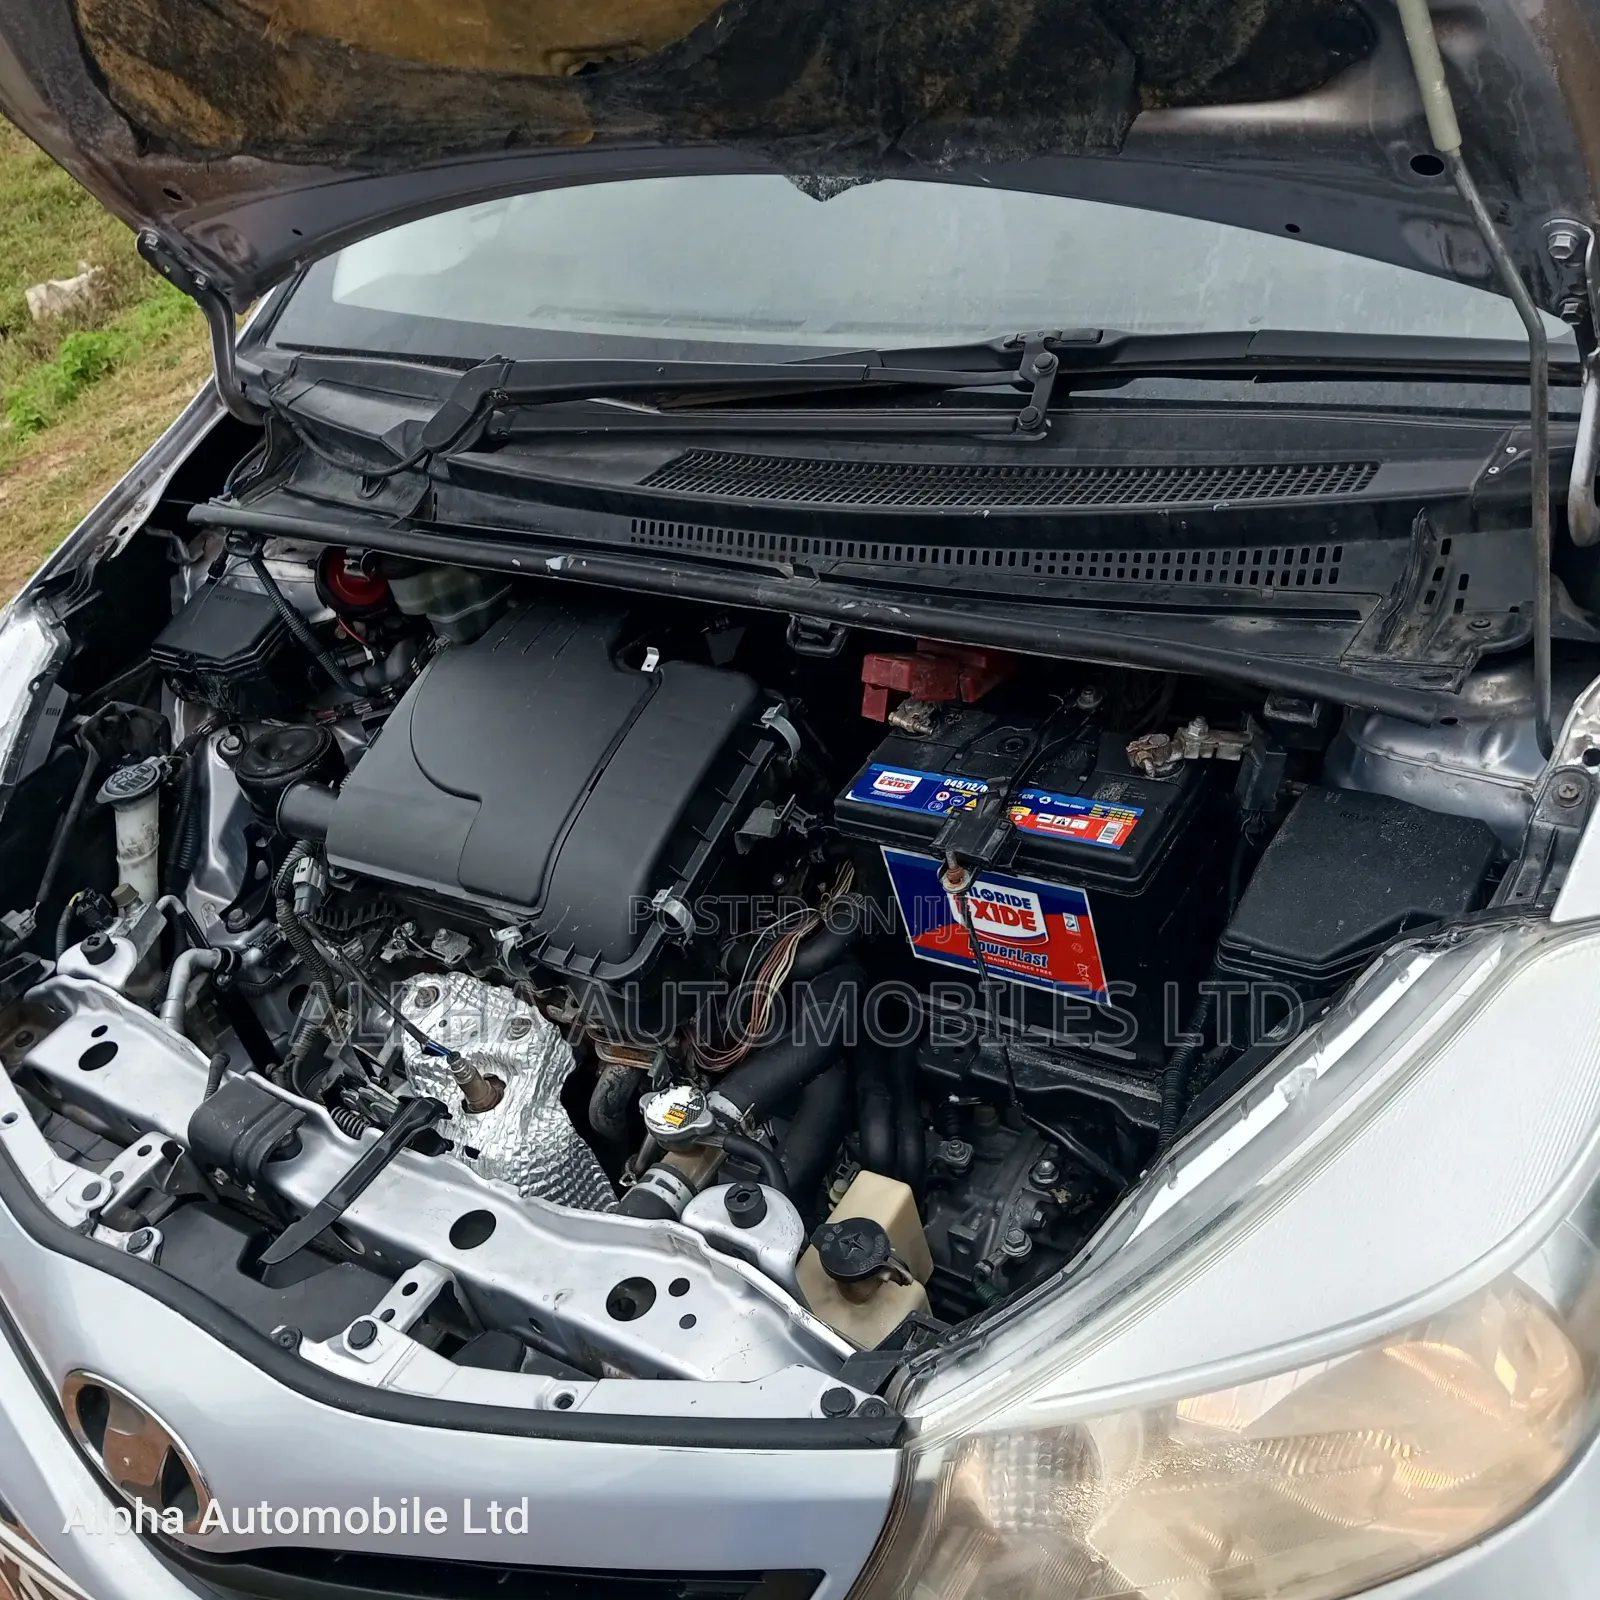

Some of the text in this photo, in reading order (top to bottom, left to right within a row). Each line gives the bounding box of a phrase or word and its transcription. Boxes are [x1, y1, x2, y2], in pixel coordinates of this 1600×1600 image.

[878, 778, 914, 790] EXIDE
[1340, 811, 1378, 823] RELAY
[965, 886, 1031, 910] HLORIDE
[987, 955, 1035, 972] MAINTENANCE
[1035, 967, 1053, 976] FREE
